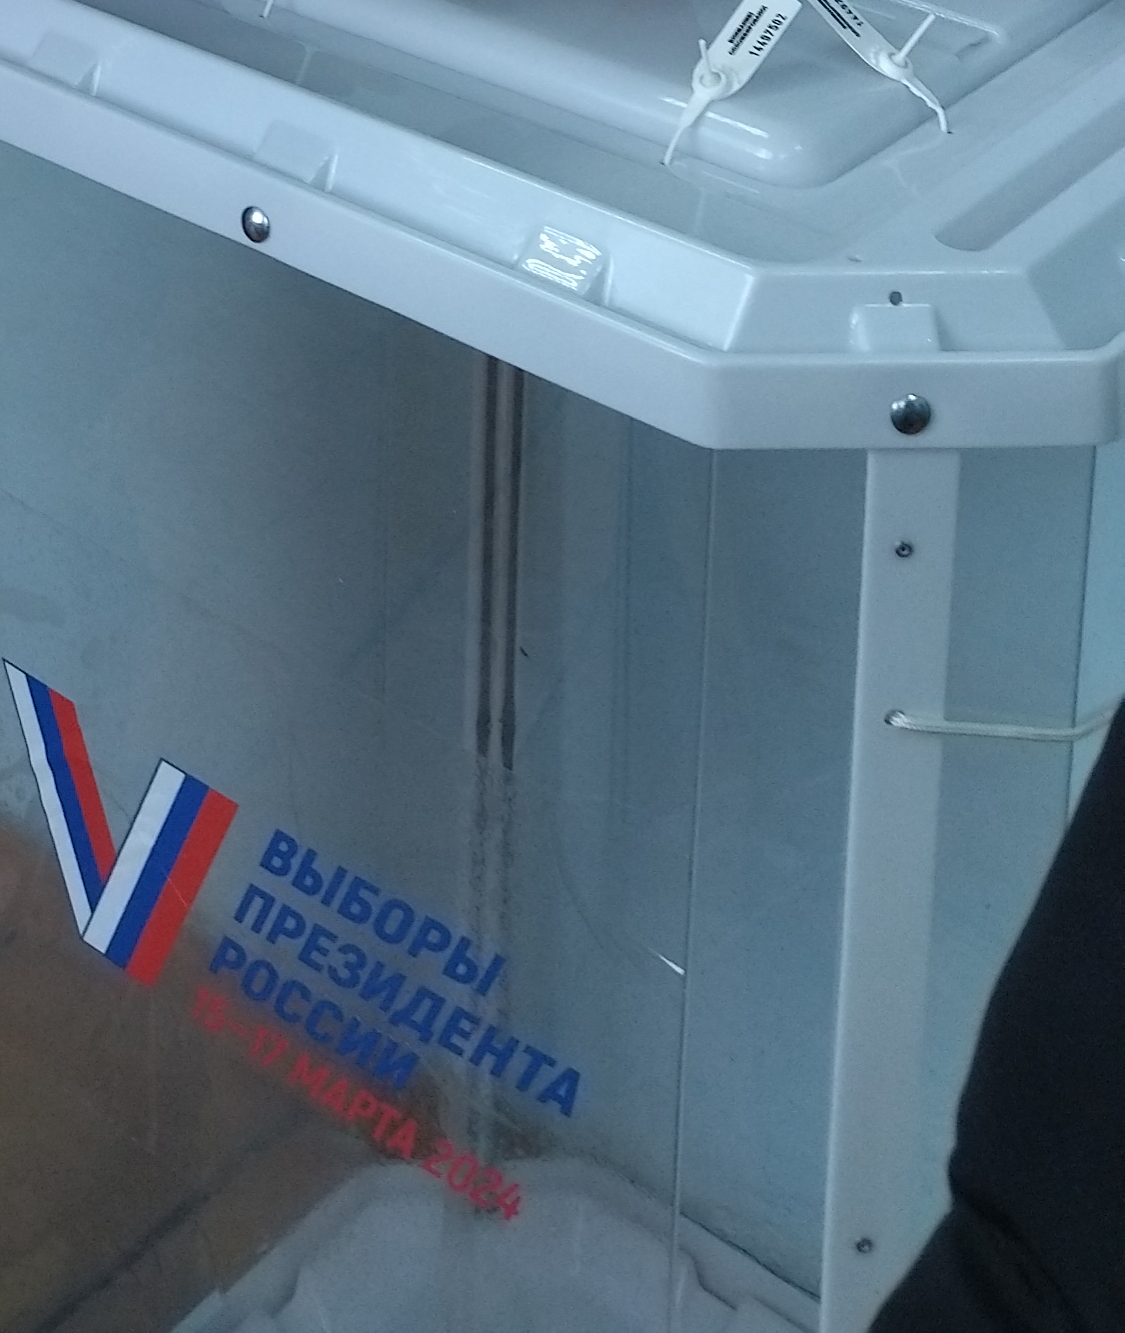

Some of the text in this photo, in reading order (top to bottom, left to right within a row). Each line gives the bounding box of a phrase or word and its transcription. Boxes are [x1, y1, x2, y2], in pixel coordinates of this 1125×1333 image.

[259, 829, 506, 997] ВЫБОРЫ
[209, 936, 421, 1090] РОССИИ
[234, 882, 580, 1118] ПРЕЗИДЕНТА
[287, 1051, 418, 1158] МАРТА
[424, 1138, 523, 1220] 2024
